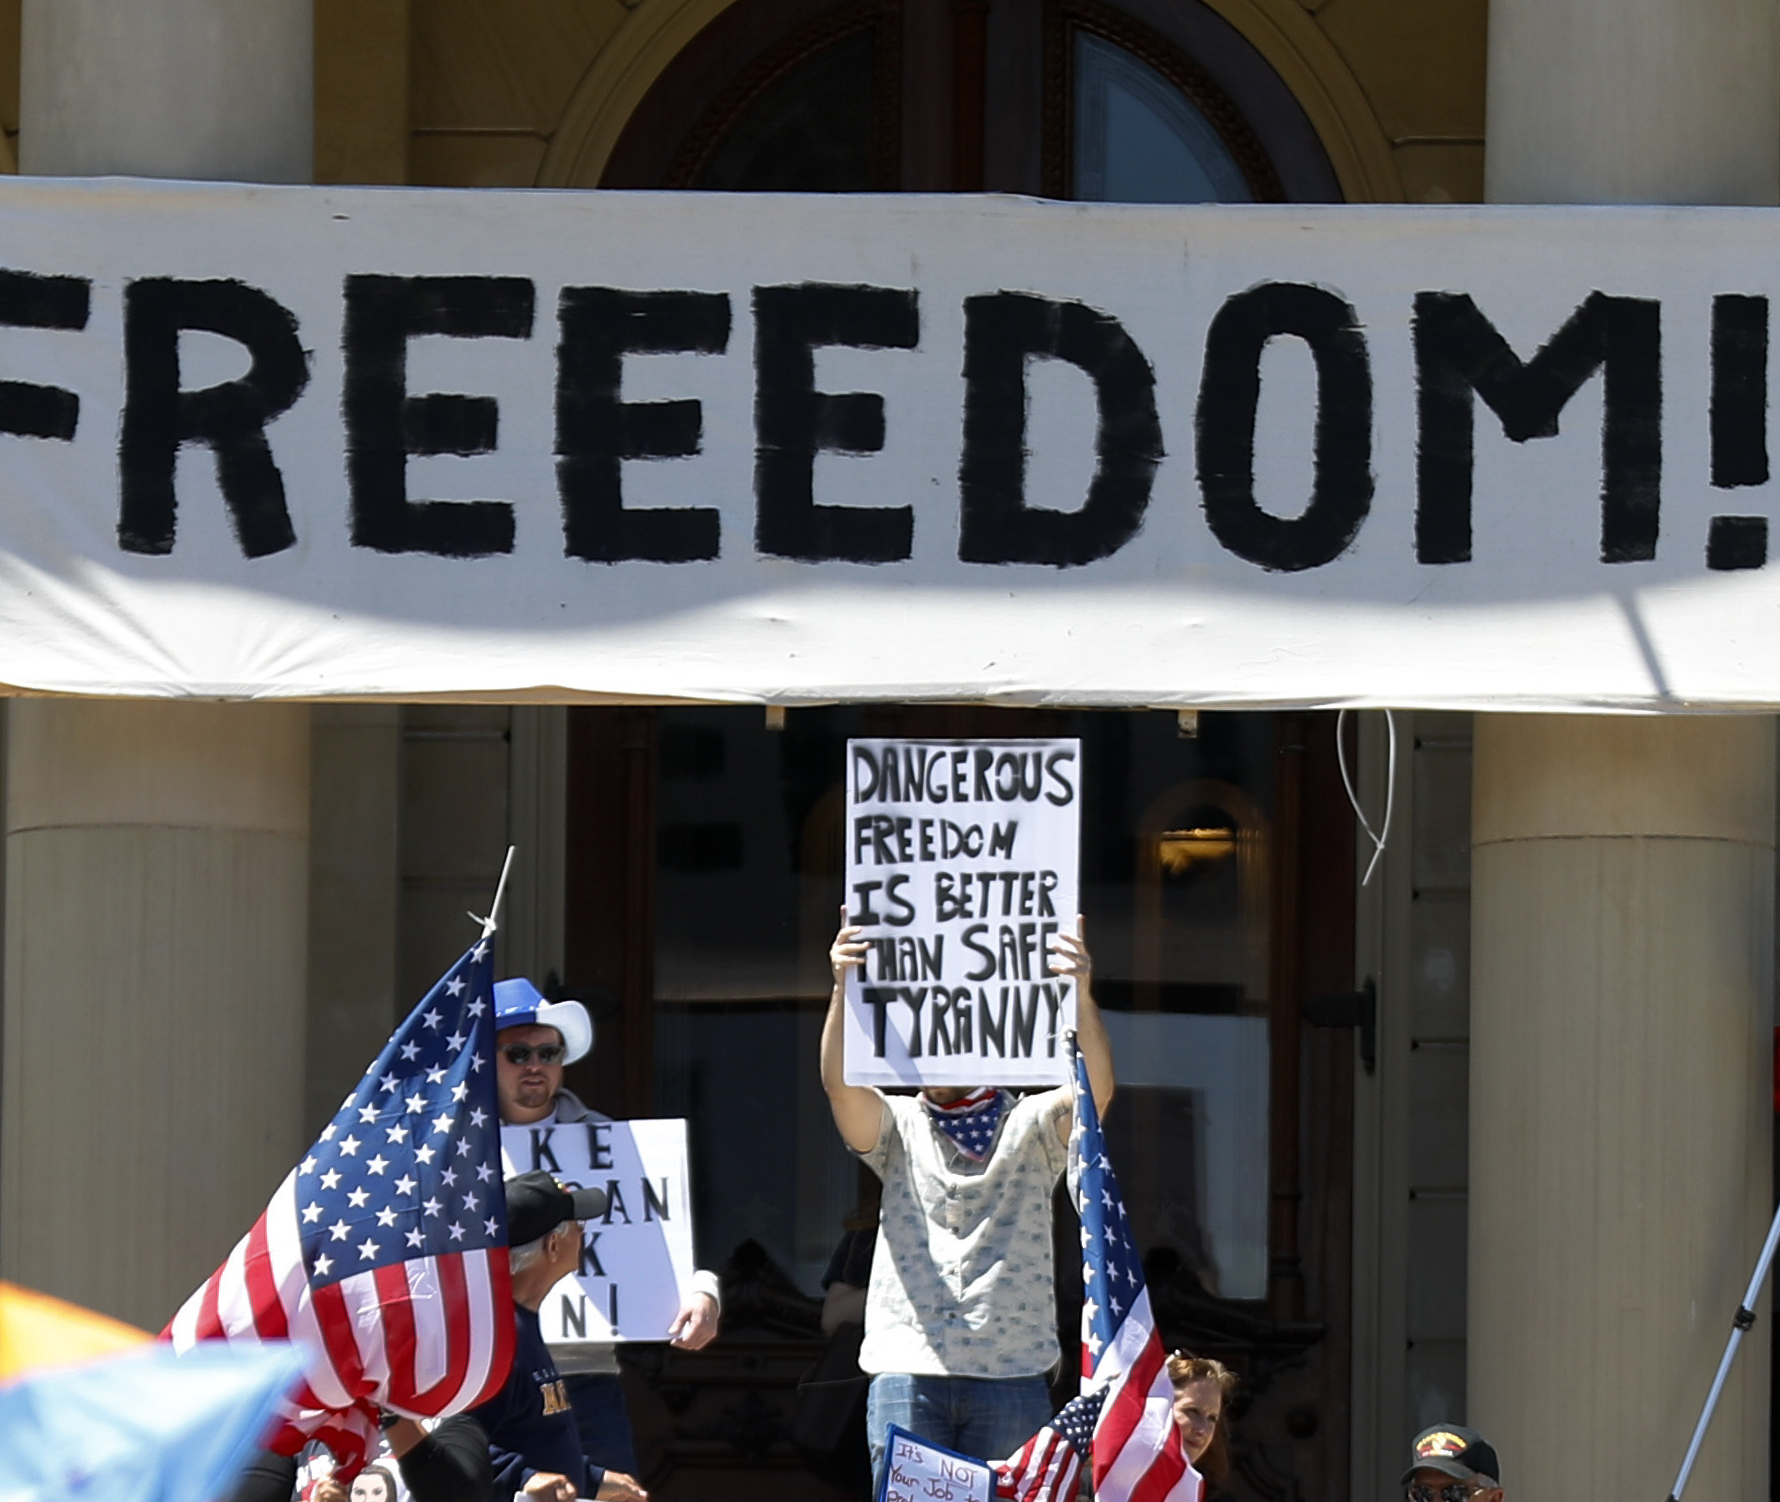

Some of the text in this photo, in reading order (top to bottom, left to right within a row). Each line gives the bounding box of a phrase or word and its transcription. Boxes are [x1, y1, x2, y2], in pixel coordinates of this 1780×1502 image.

[852, 746, 1075, 807] DANGEROUS
[854, 815, 1018, 866] FREEDOM
[848, 870, 1058, 927] IS BETTER
[855, 922, 1060, 983] THAN SAFE
[861, 984, 1070, 1058] TYRANNY
[890, 1463, 920, 1488] Your
[922, 1477, 954, 1502] Job
[895, 1441, 979, 1490] It's NOT
